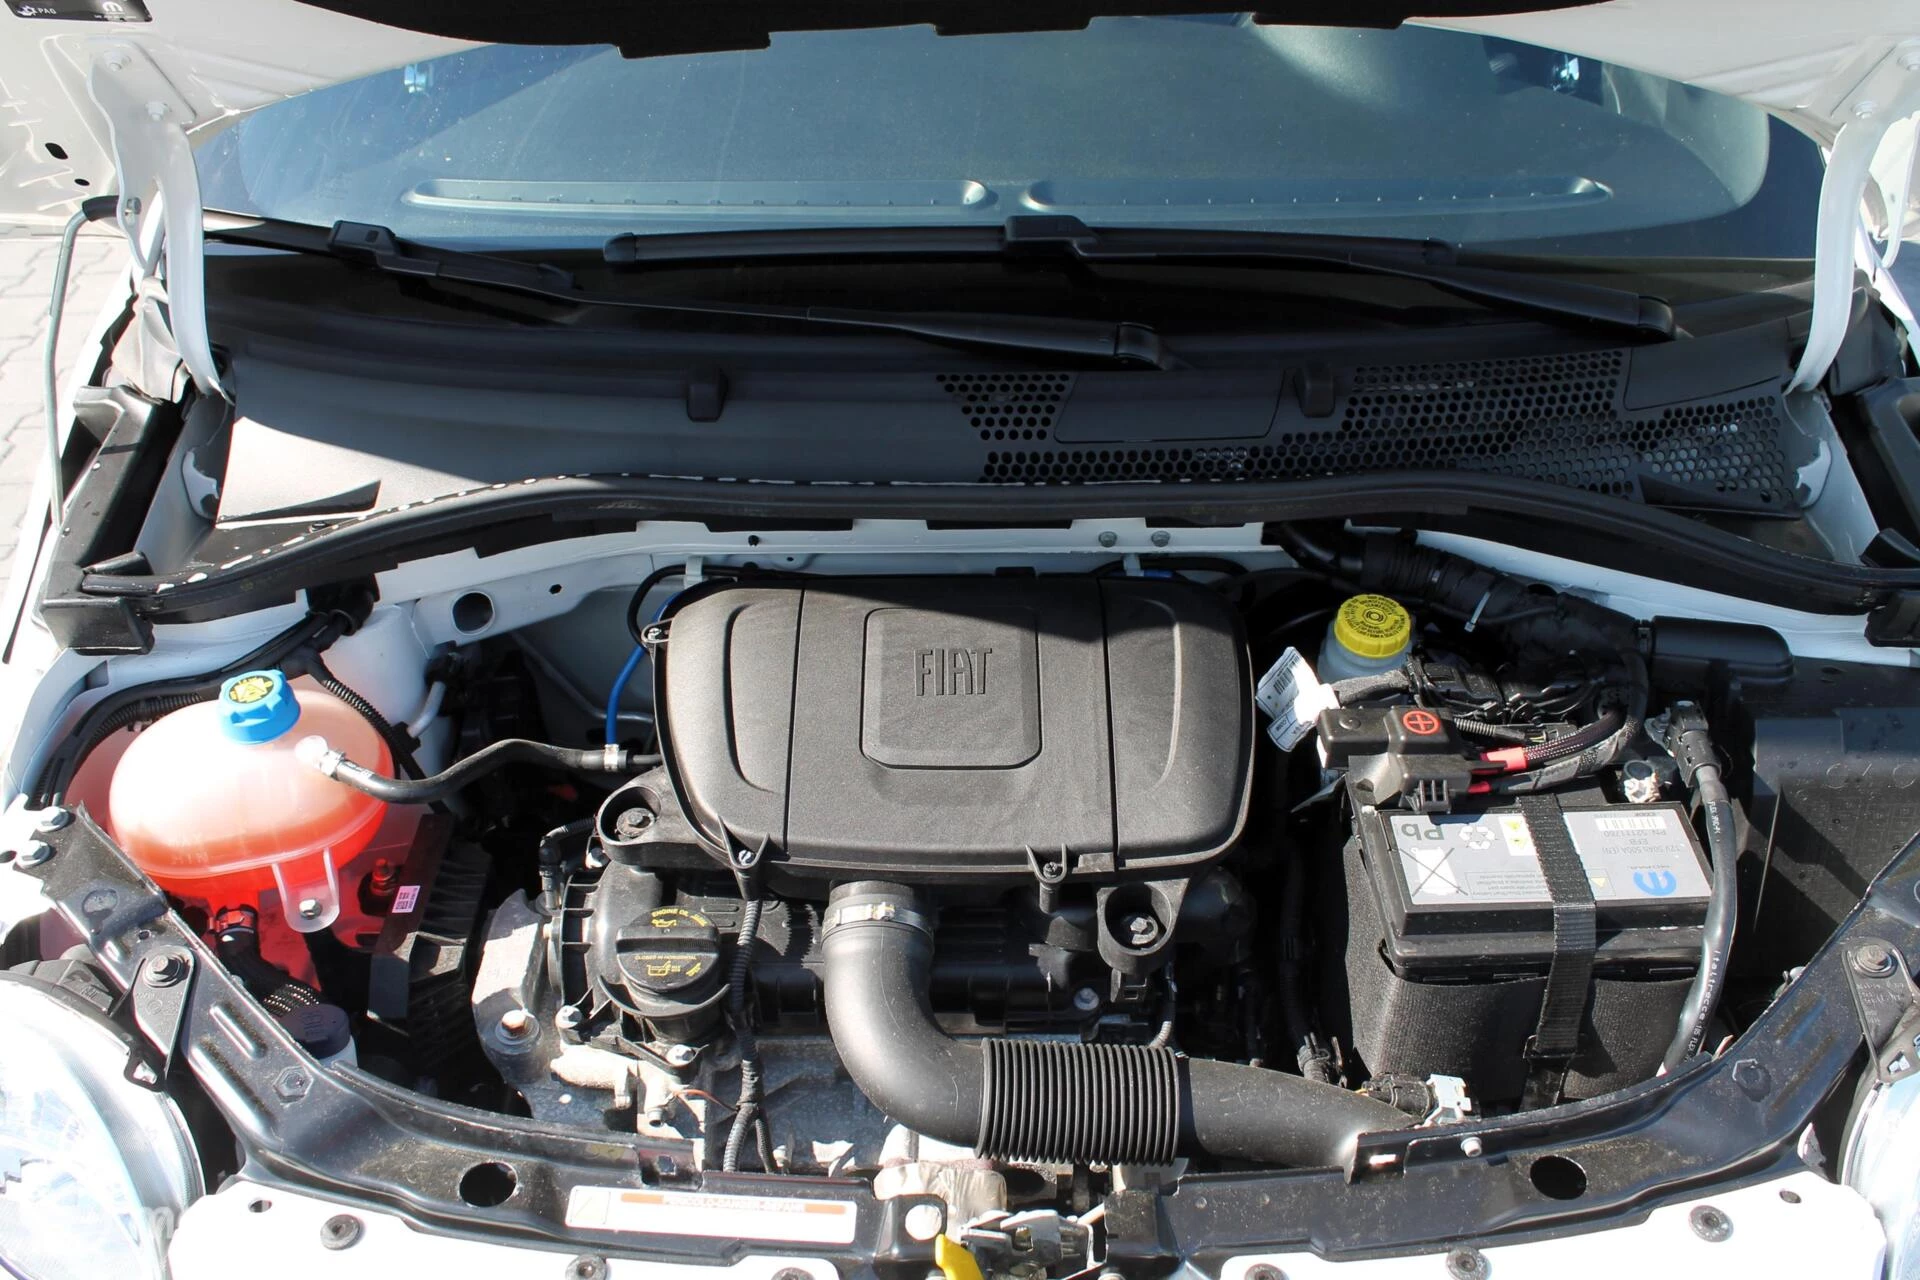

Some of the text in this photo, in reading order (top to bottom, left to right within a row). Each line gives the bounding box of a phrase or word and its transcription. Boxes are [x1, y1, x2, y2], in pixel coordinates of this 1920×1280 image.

[914, 647, 992, 696] FIAT
[1401, 823, 1445, 841] Pb
[651, 908, 679, 917] ENGINE
